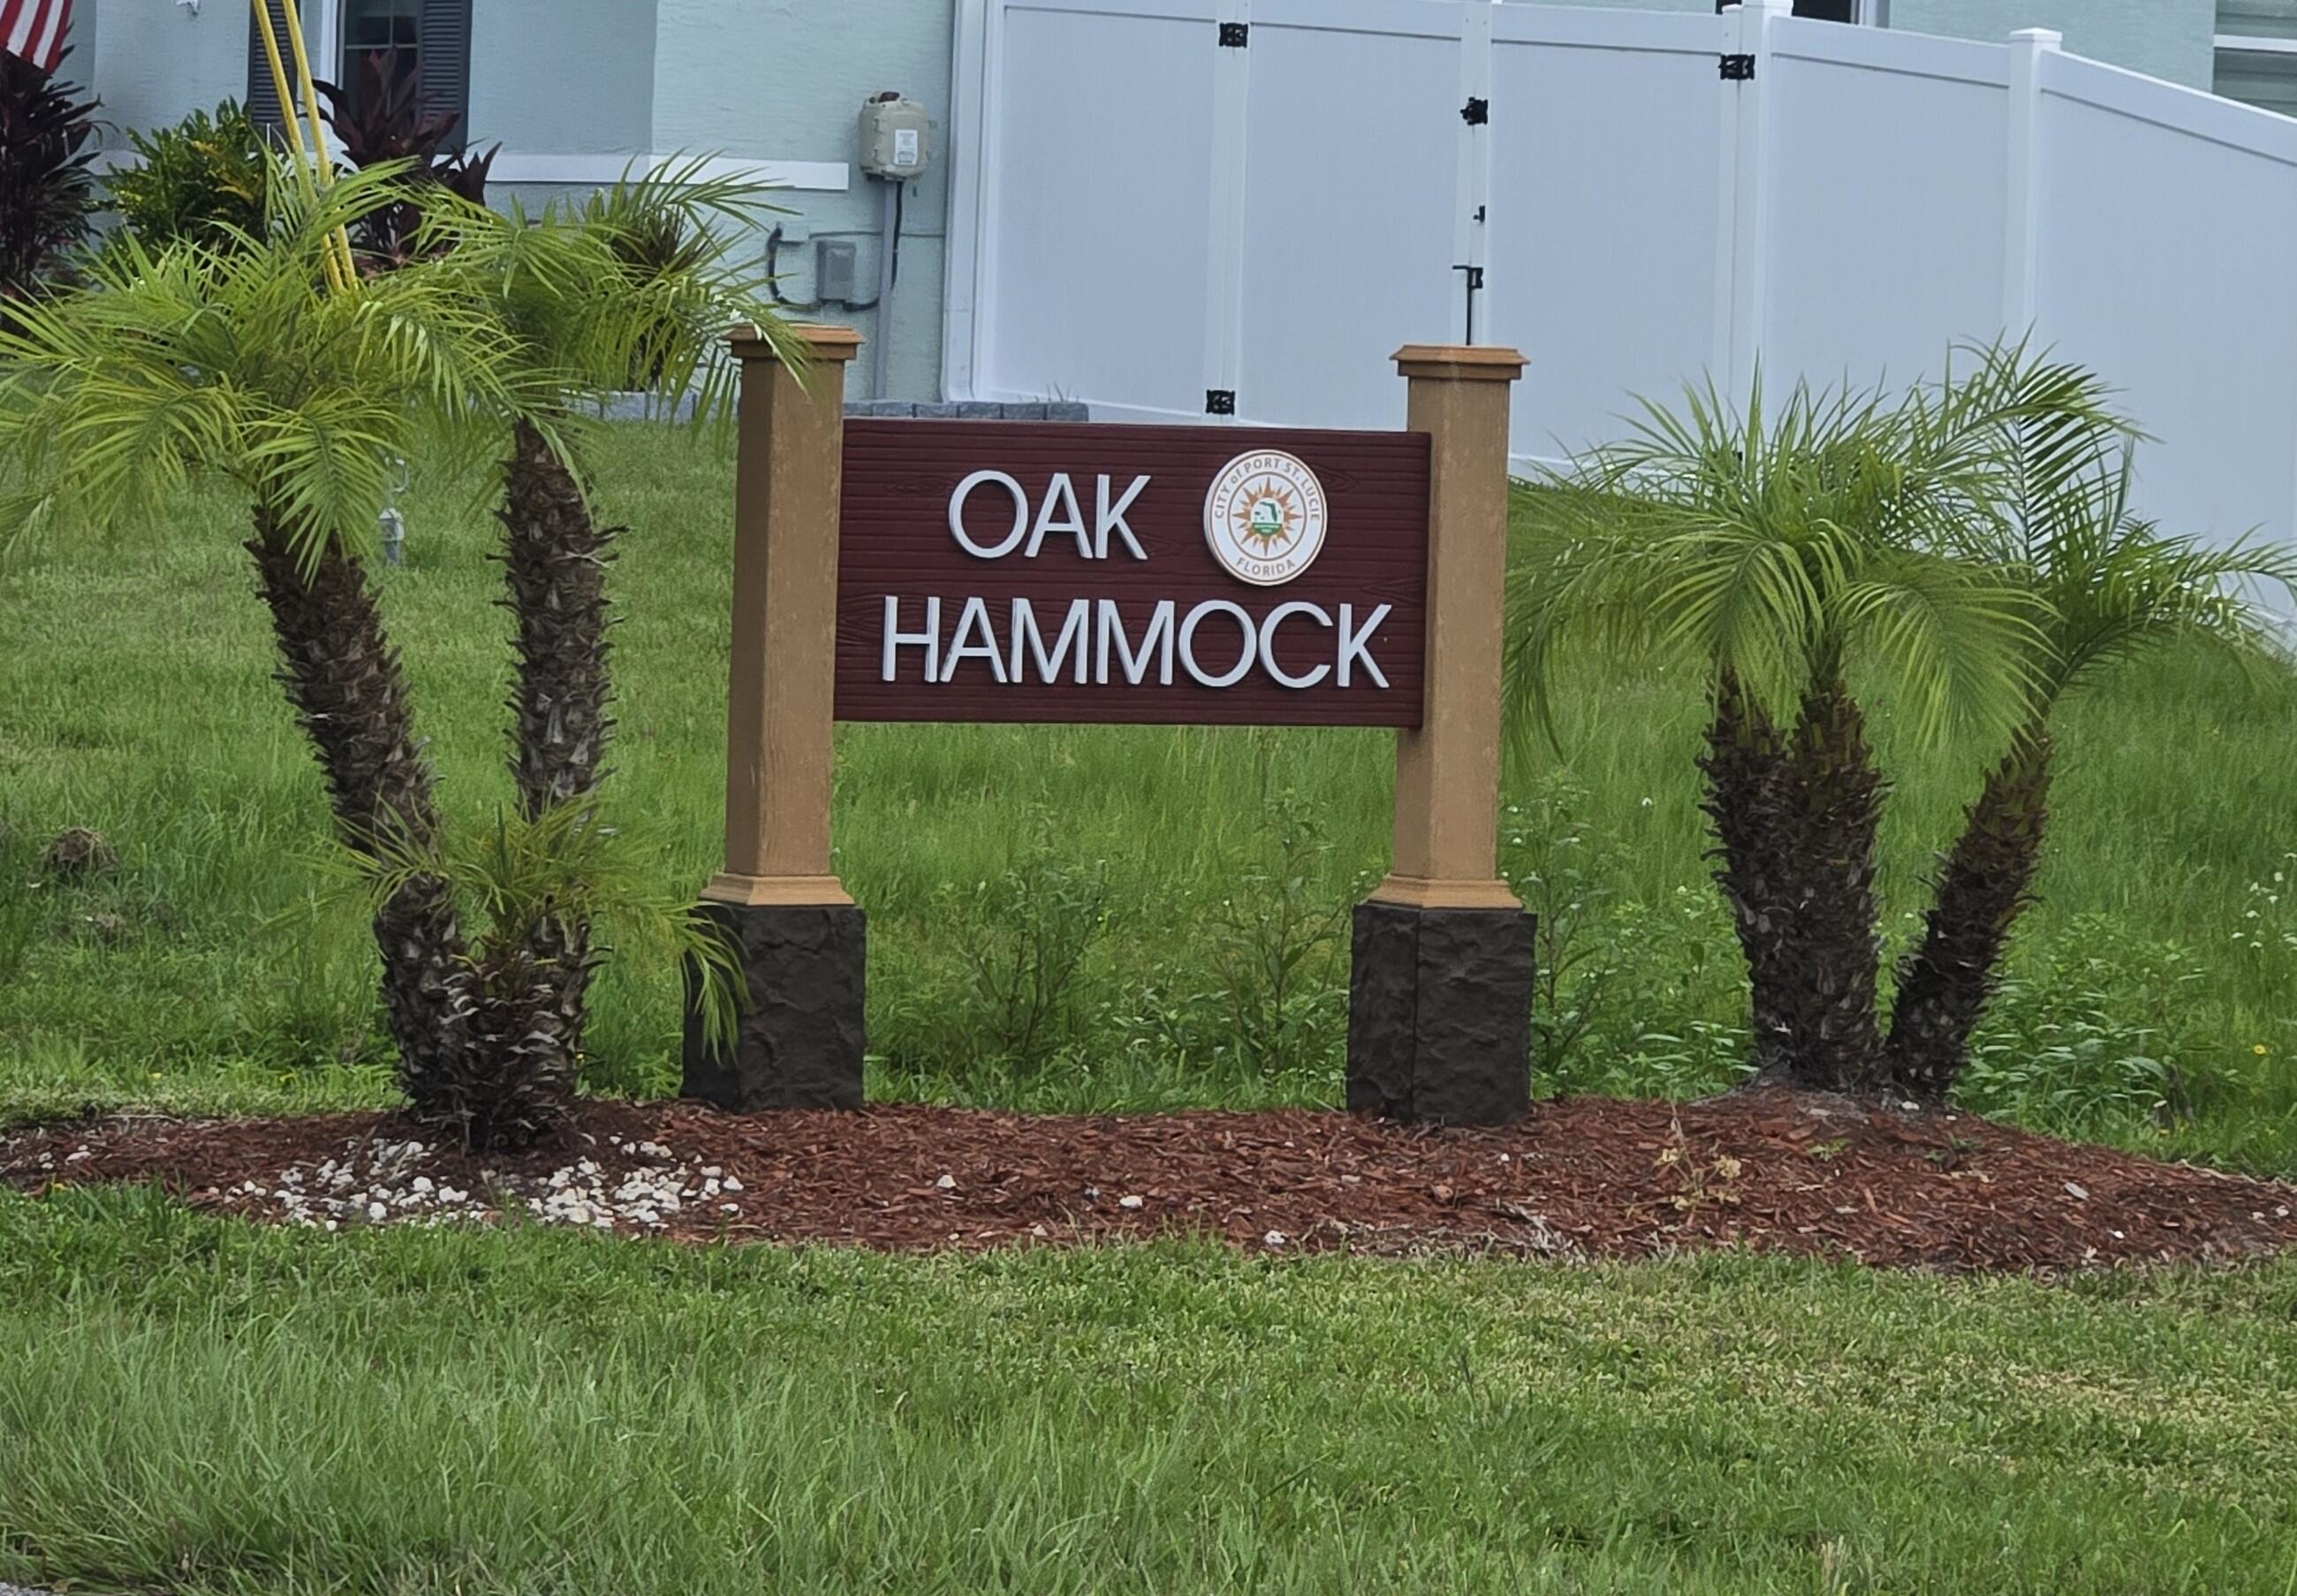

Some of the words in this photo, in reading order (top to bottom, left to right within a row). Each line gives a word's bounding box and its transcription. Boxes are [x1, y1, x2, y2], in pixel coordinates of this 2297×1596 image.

[948, 469, 1151, 561] OAK
[1215, 485, 1230, 518] CITY
[1244, 458, 1281, 473] PORT
[1284, 463, 1300, 481] ST.
[1300, 479, 1321, 521] LUCIE
[1236, 557, 1296, 577] FLORIDA
[882, 595, 1392, 689] HAMMOCK
